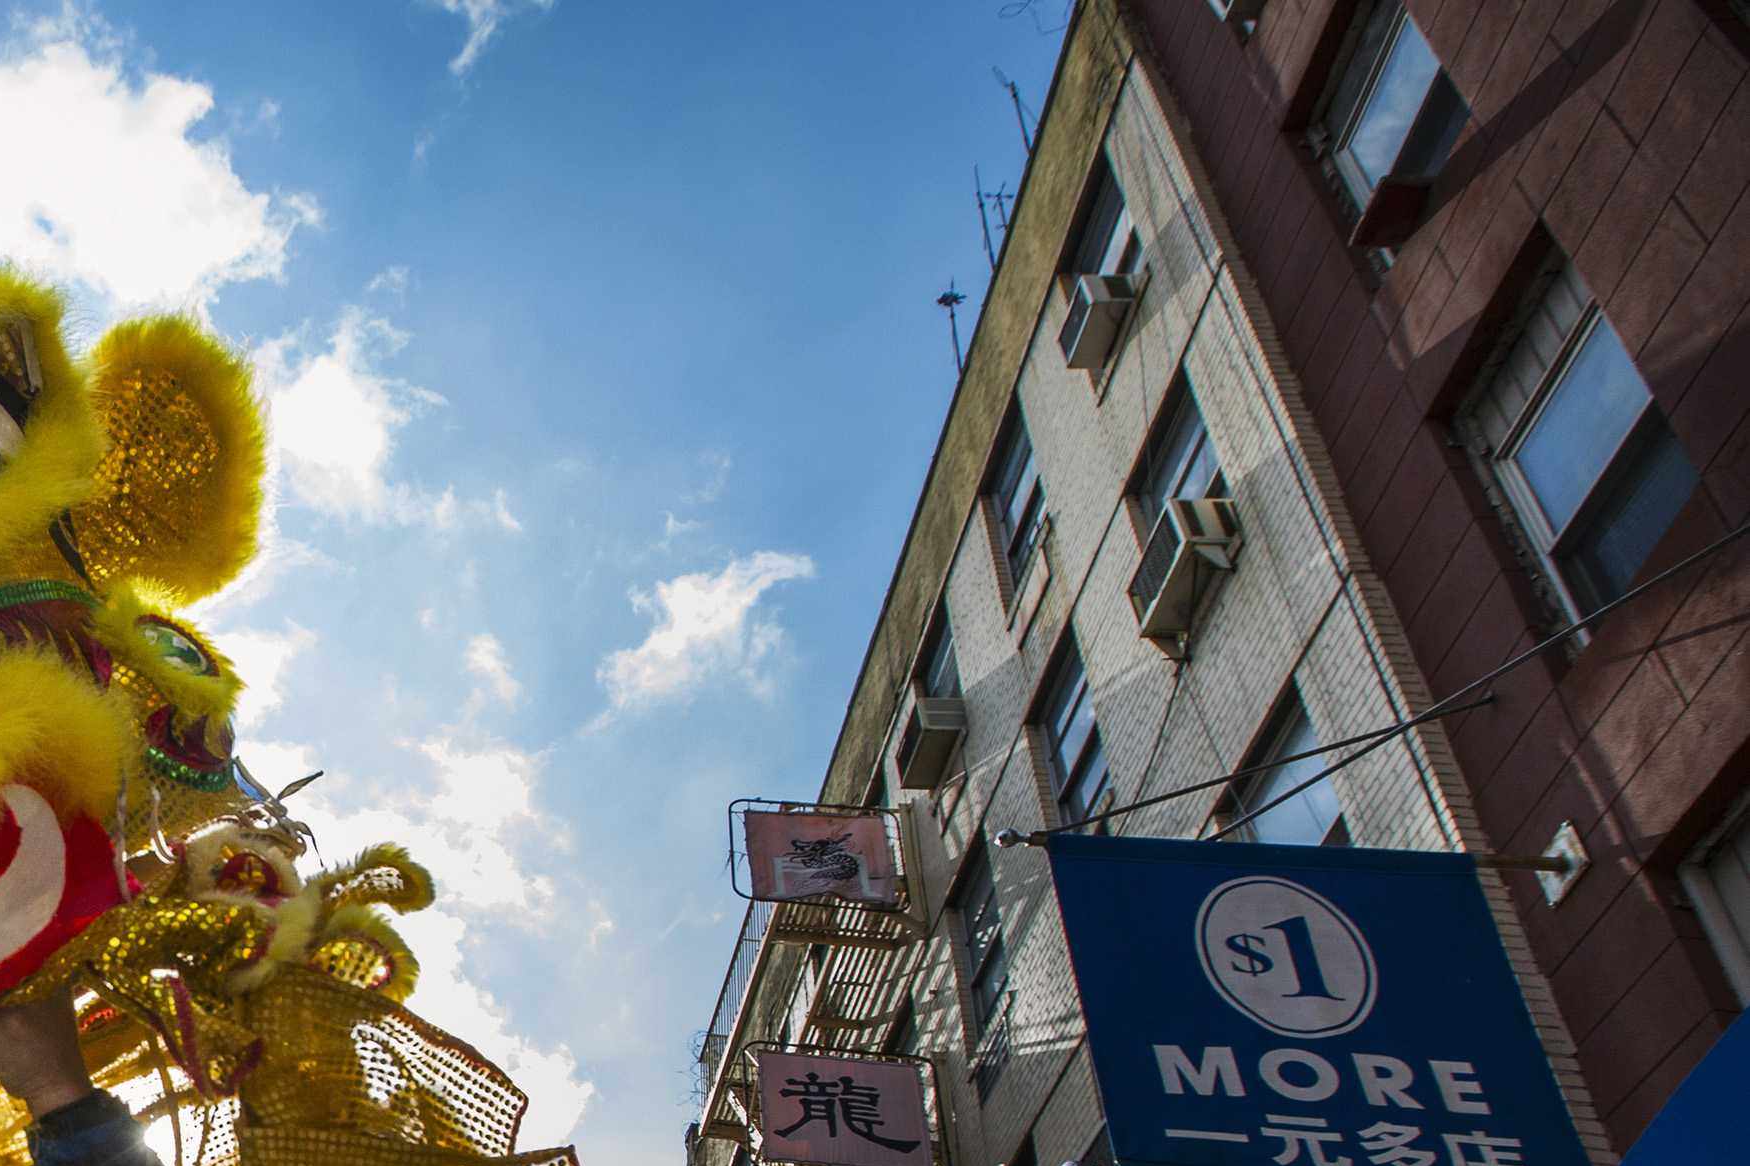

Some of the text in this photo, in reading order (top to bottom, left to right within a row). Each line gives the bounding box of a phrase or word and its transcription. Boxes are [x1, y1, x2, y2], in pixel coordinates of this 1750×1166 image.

[1224, 915, 1347, 1002] $1
[773, 1071, 921, 1153] 龍
[1152, 1043, 1492, 1116] MORE
